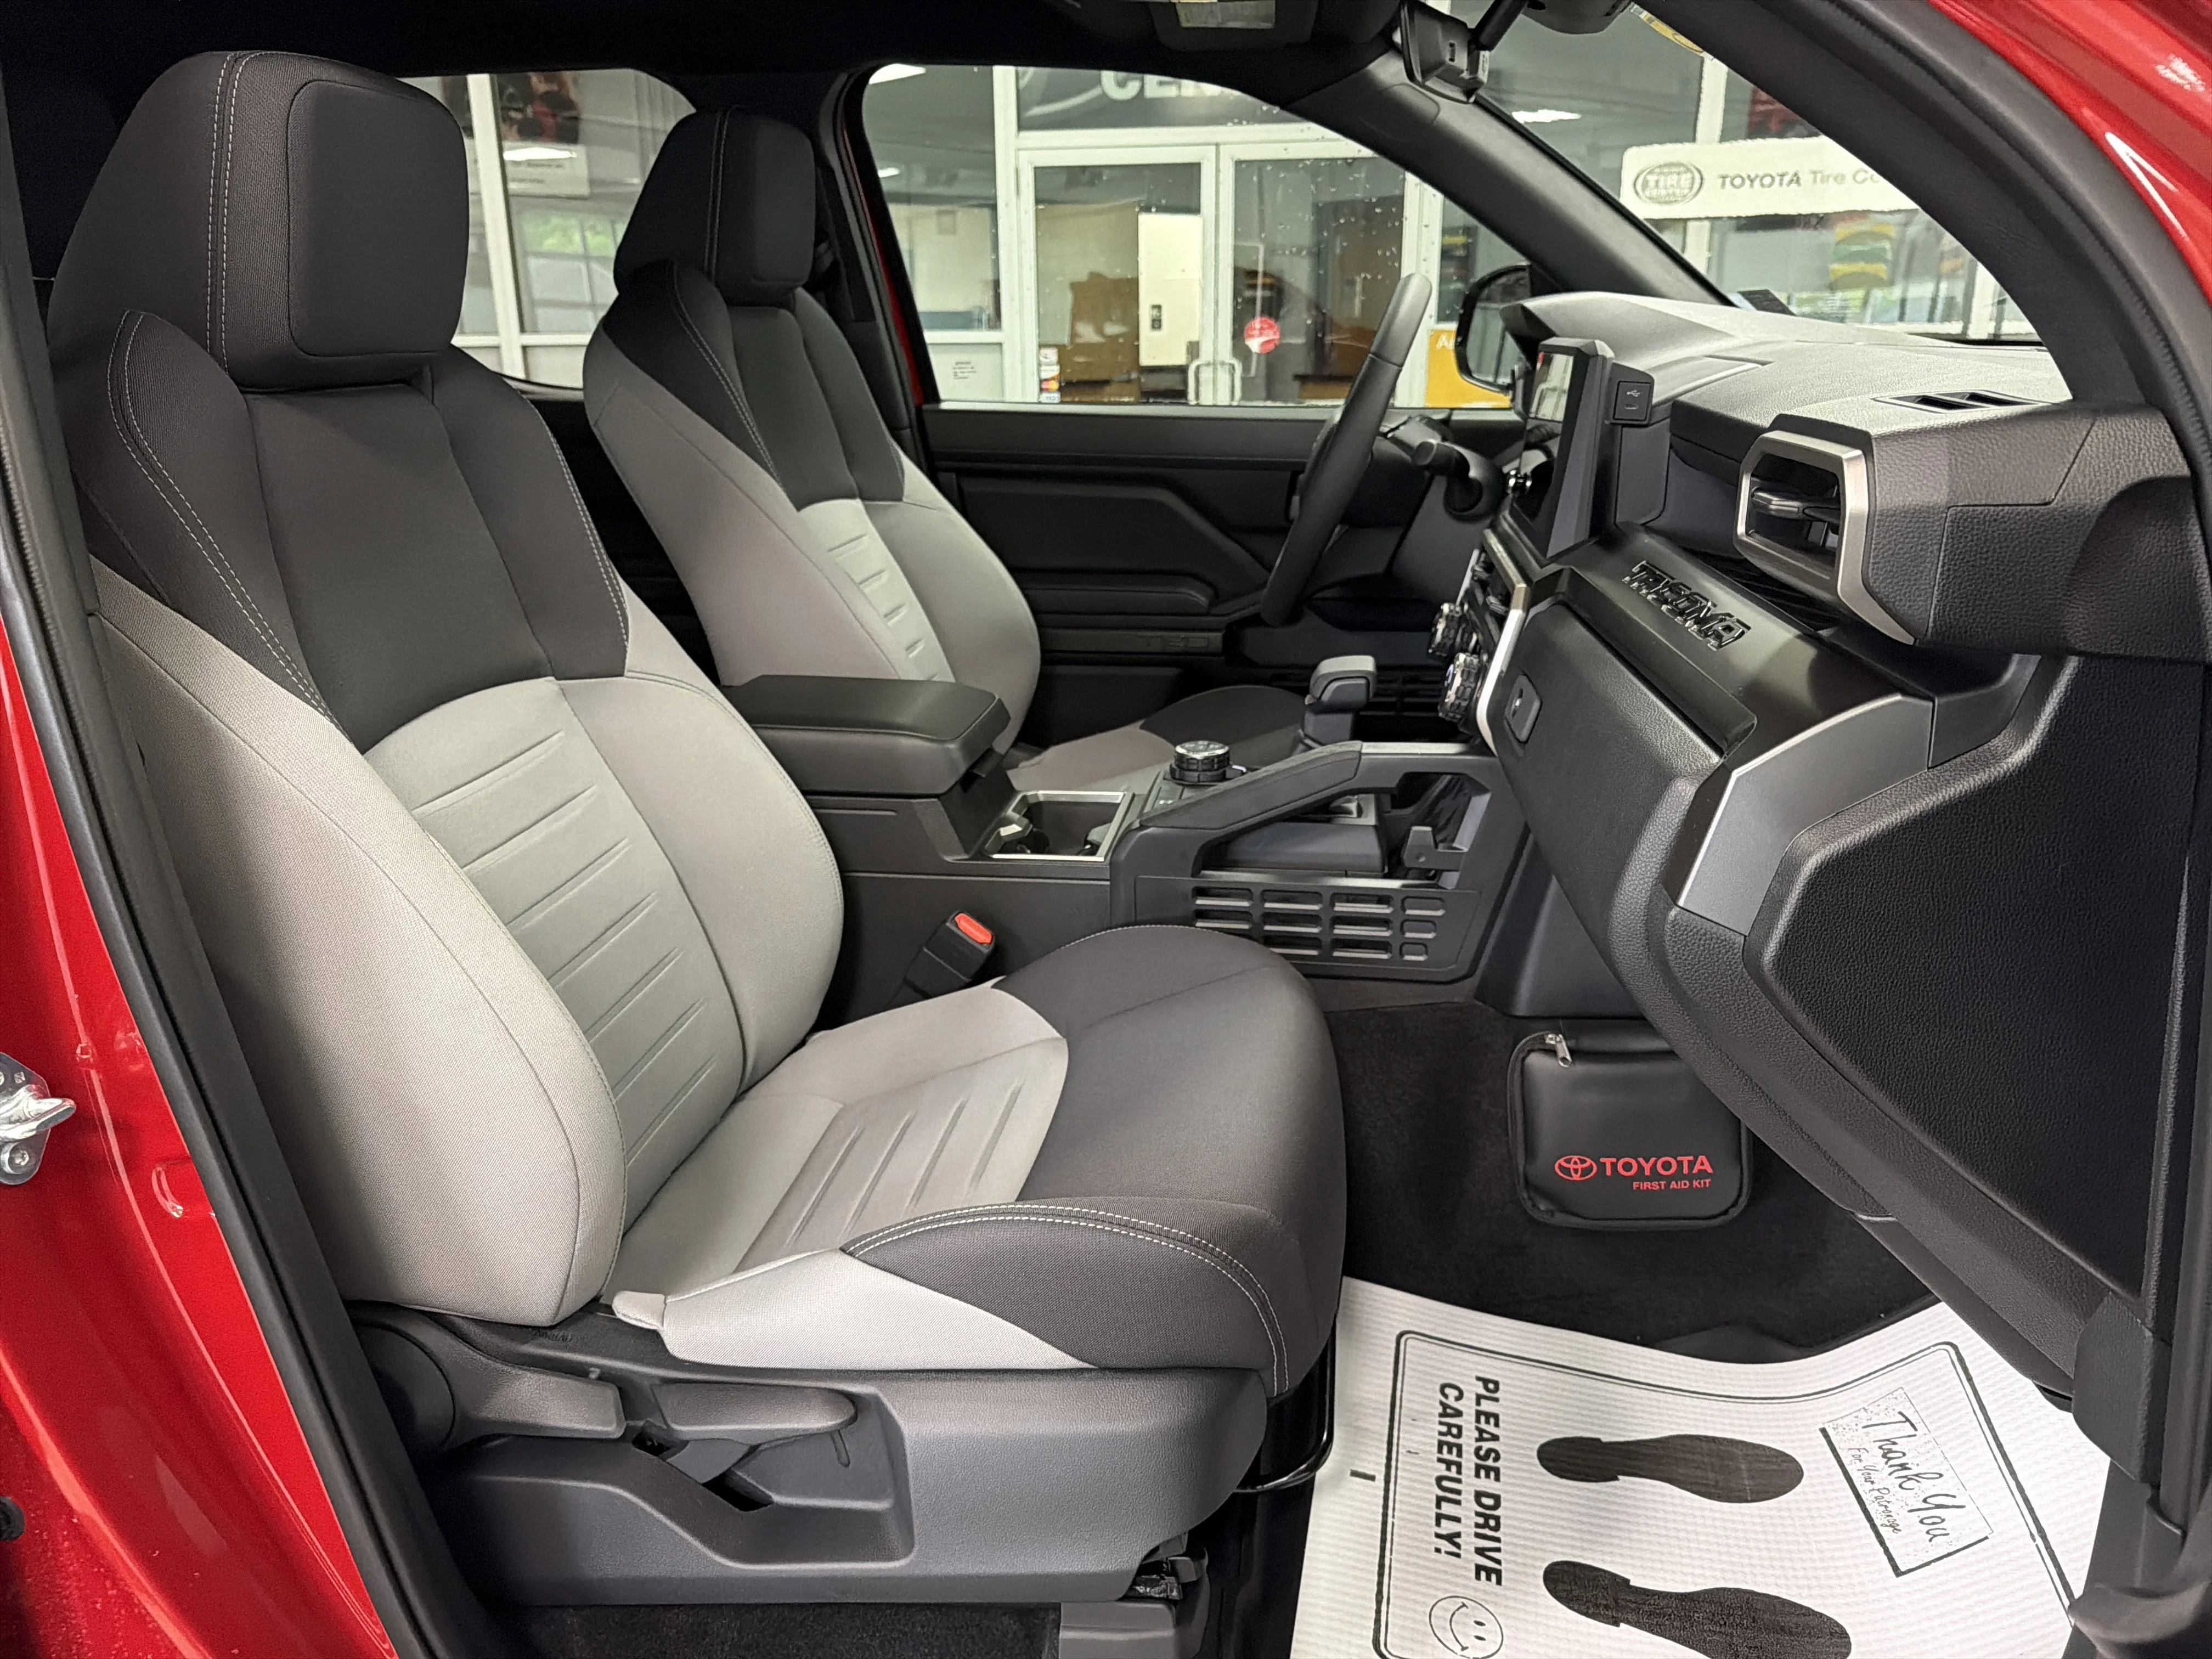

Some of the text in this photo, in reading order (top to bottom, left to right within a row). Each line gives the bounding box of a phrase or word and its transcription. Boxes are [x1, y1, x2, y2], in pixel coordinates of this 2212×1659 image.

[1718, 170, 1802, 190] TOYOTA
[1810, 170, 1847, 185] Tire
[1600, 1155, 1713, 1176] TOYOTA
[1633, 1179, 1712, 1190] FIRST AID KIT
[1434, 1382, 1464, 1559] CAREFULLY!
[1474, 1375, 1502, 1586] PLEASE DRIVE
[1847, 1447, 1903, 1534] For Your Patronage
[1861, 1410, 1966, 1543] Thank You
